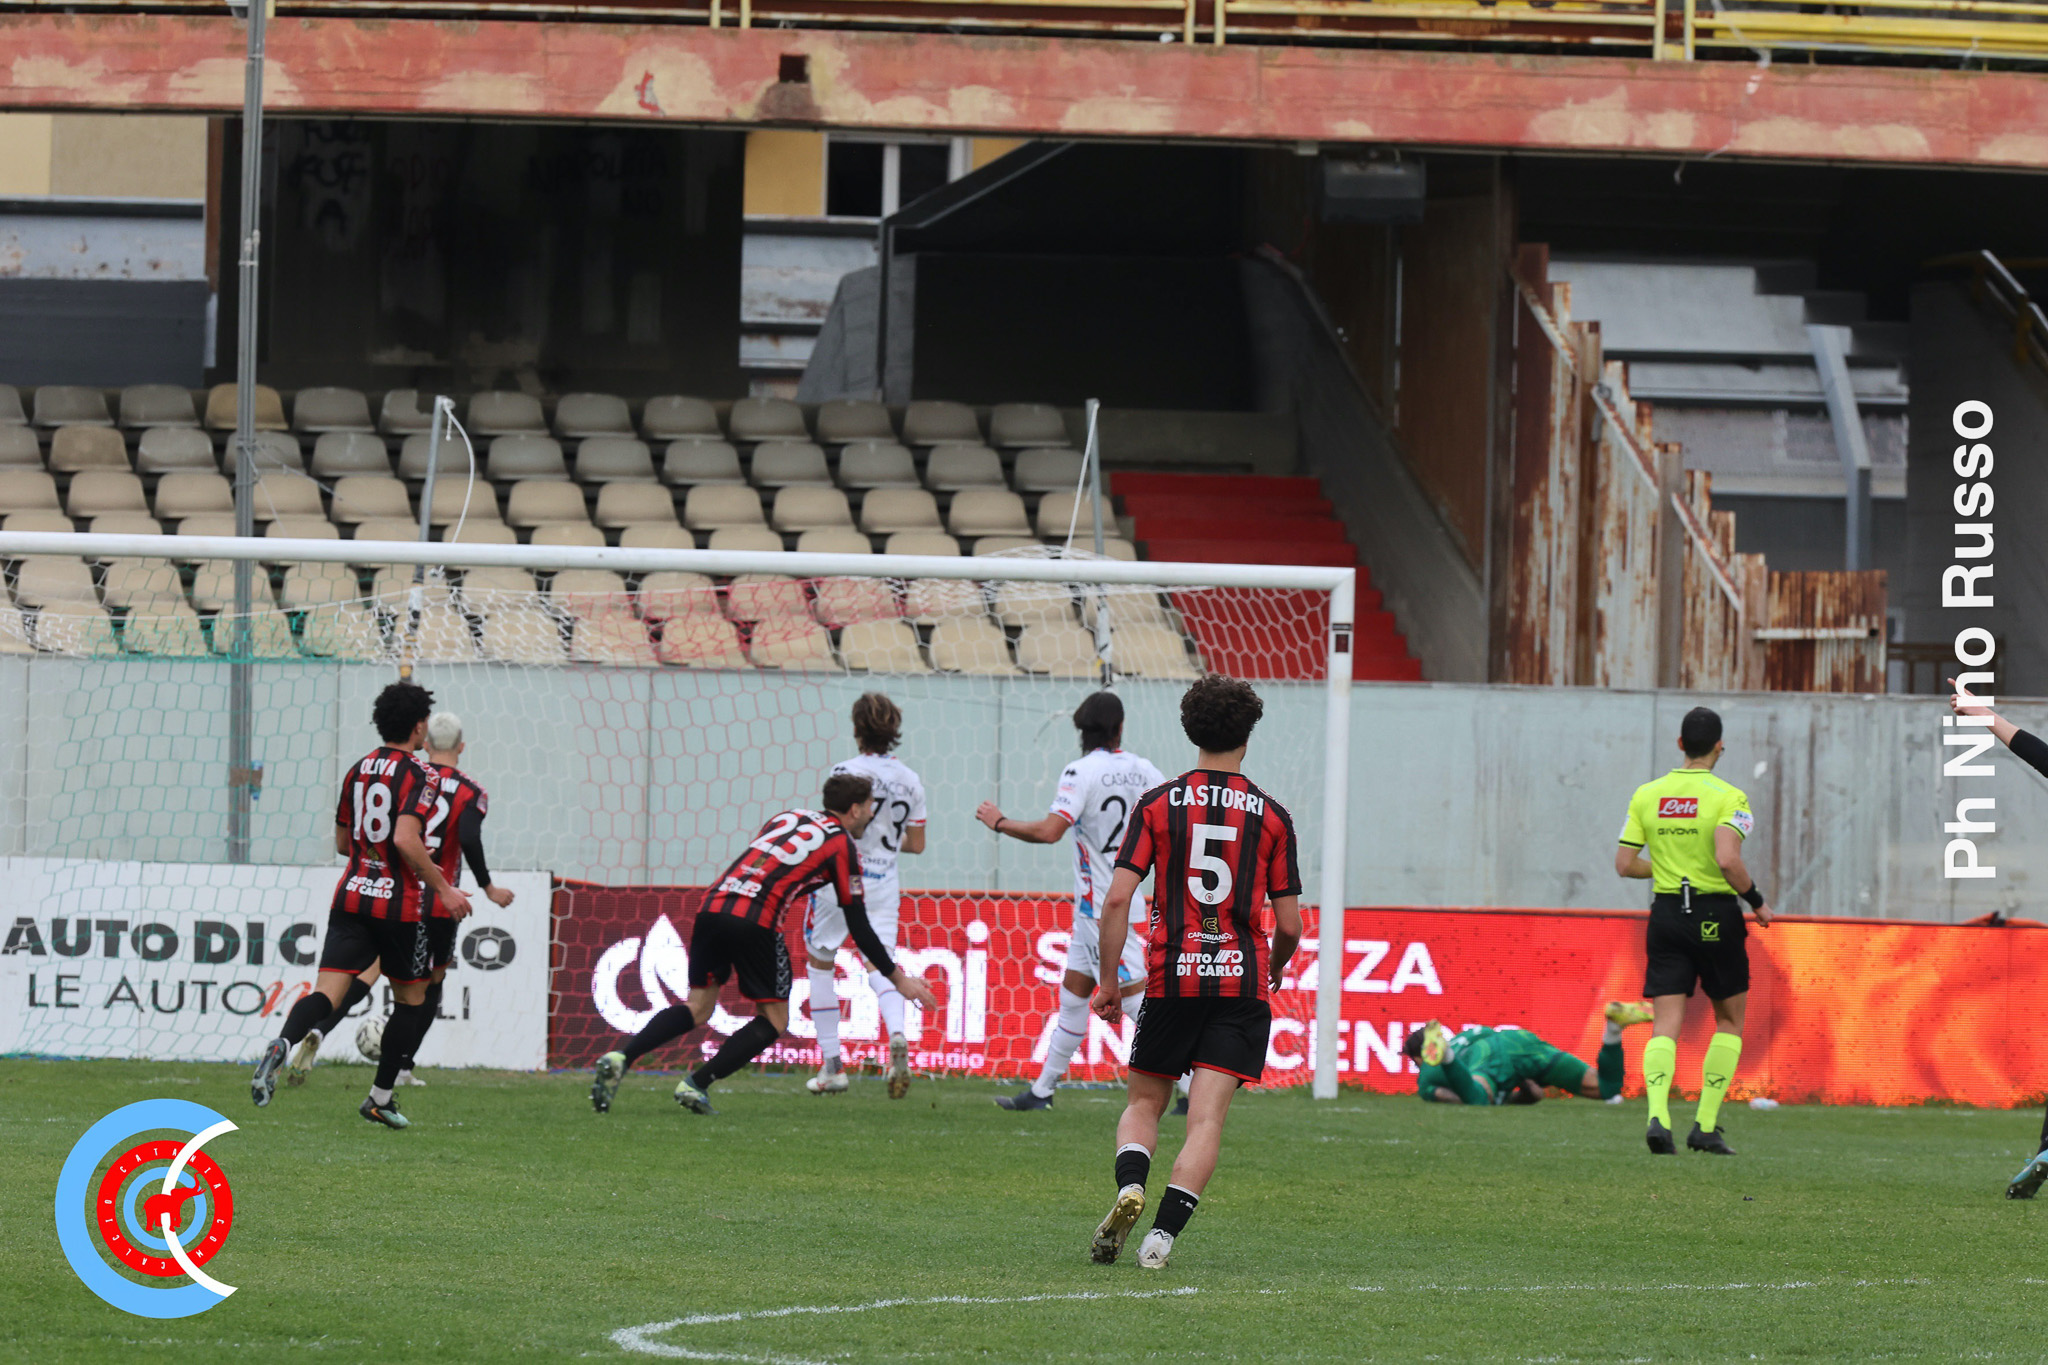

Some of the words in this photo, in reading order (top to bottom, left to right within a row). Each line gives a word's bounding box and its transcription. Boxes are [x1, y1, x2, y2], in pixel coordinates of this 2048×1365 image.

[360, 758, 398, 777] OLIVA
[353, 781, 392, 844] 18
[1169, 785, 1264, 817] CASTORRI
[1659, 798, 1698, 816] Lete
[749, 813, 825, 866] 23
[1657, 827, 1699, 836] GIVOVA
[1187, 823, 1237, 905] 5
[1, 917, 179, 962] AUTO
[194, 920, 265, 965] DI
[1176, 964, 1192, 977] DI
[1196, 964, 1245, 977] CARLO
[1177, 953, 1213, 964] AUTO
[28, 974, 81, 1008] LE
